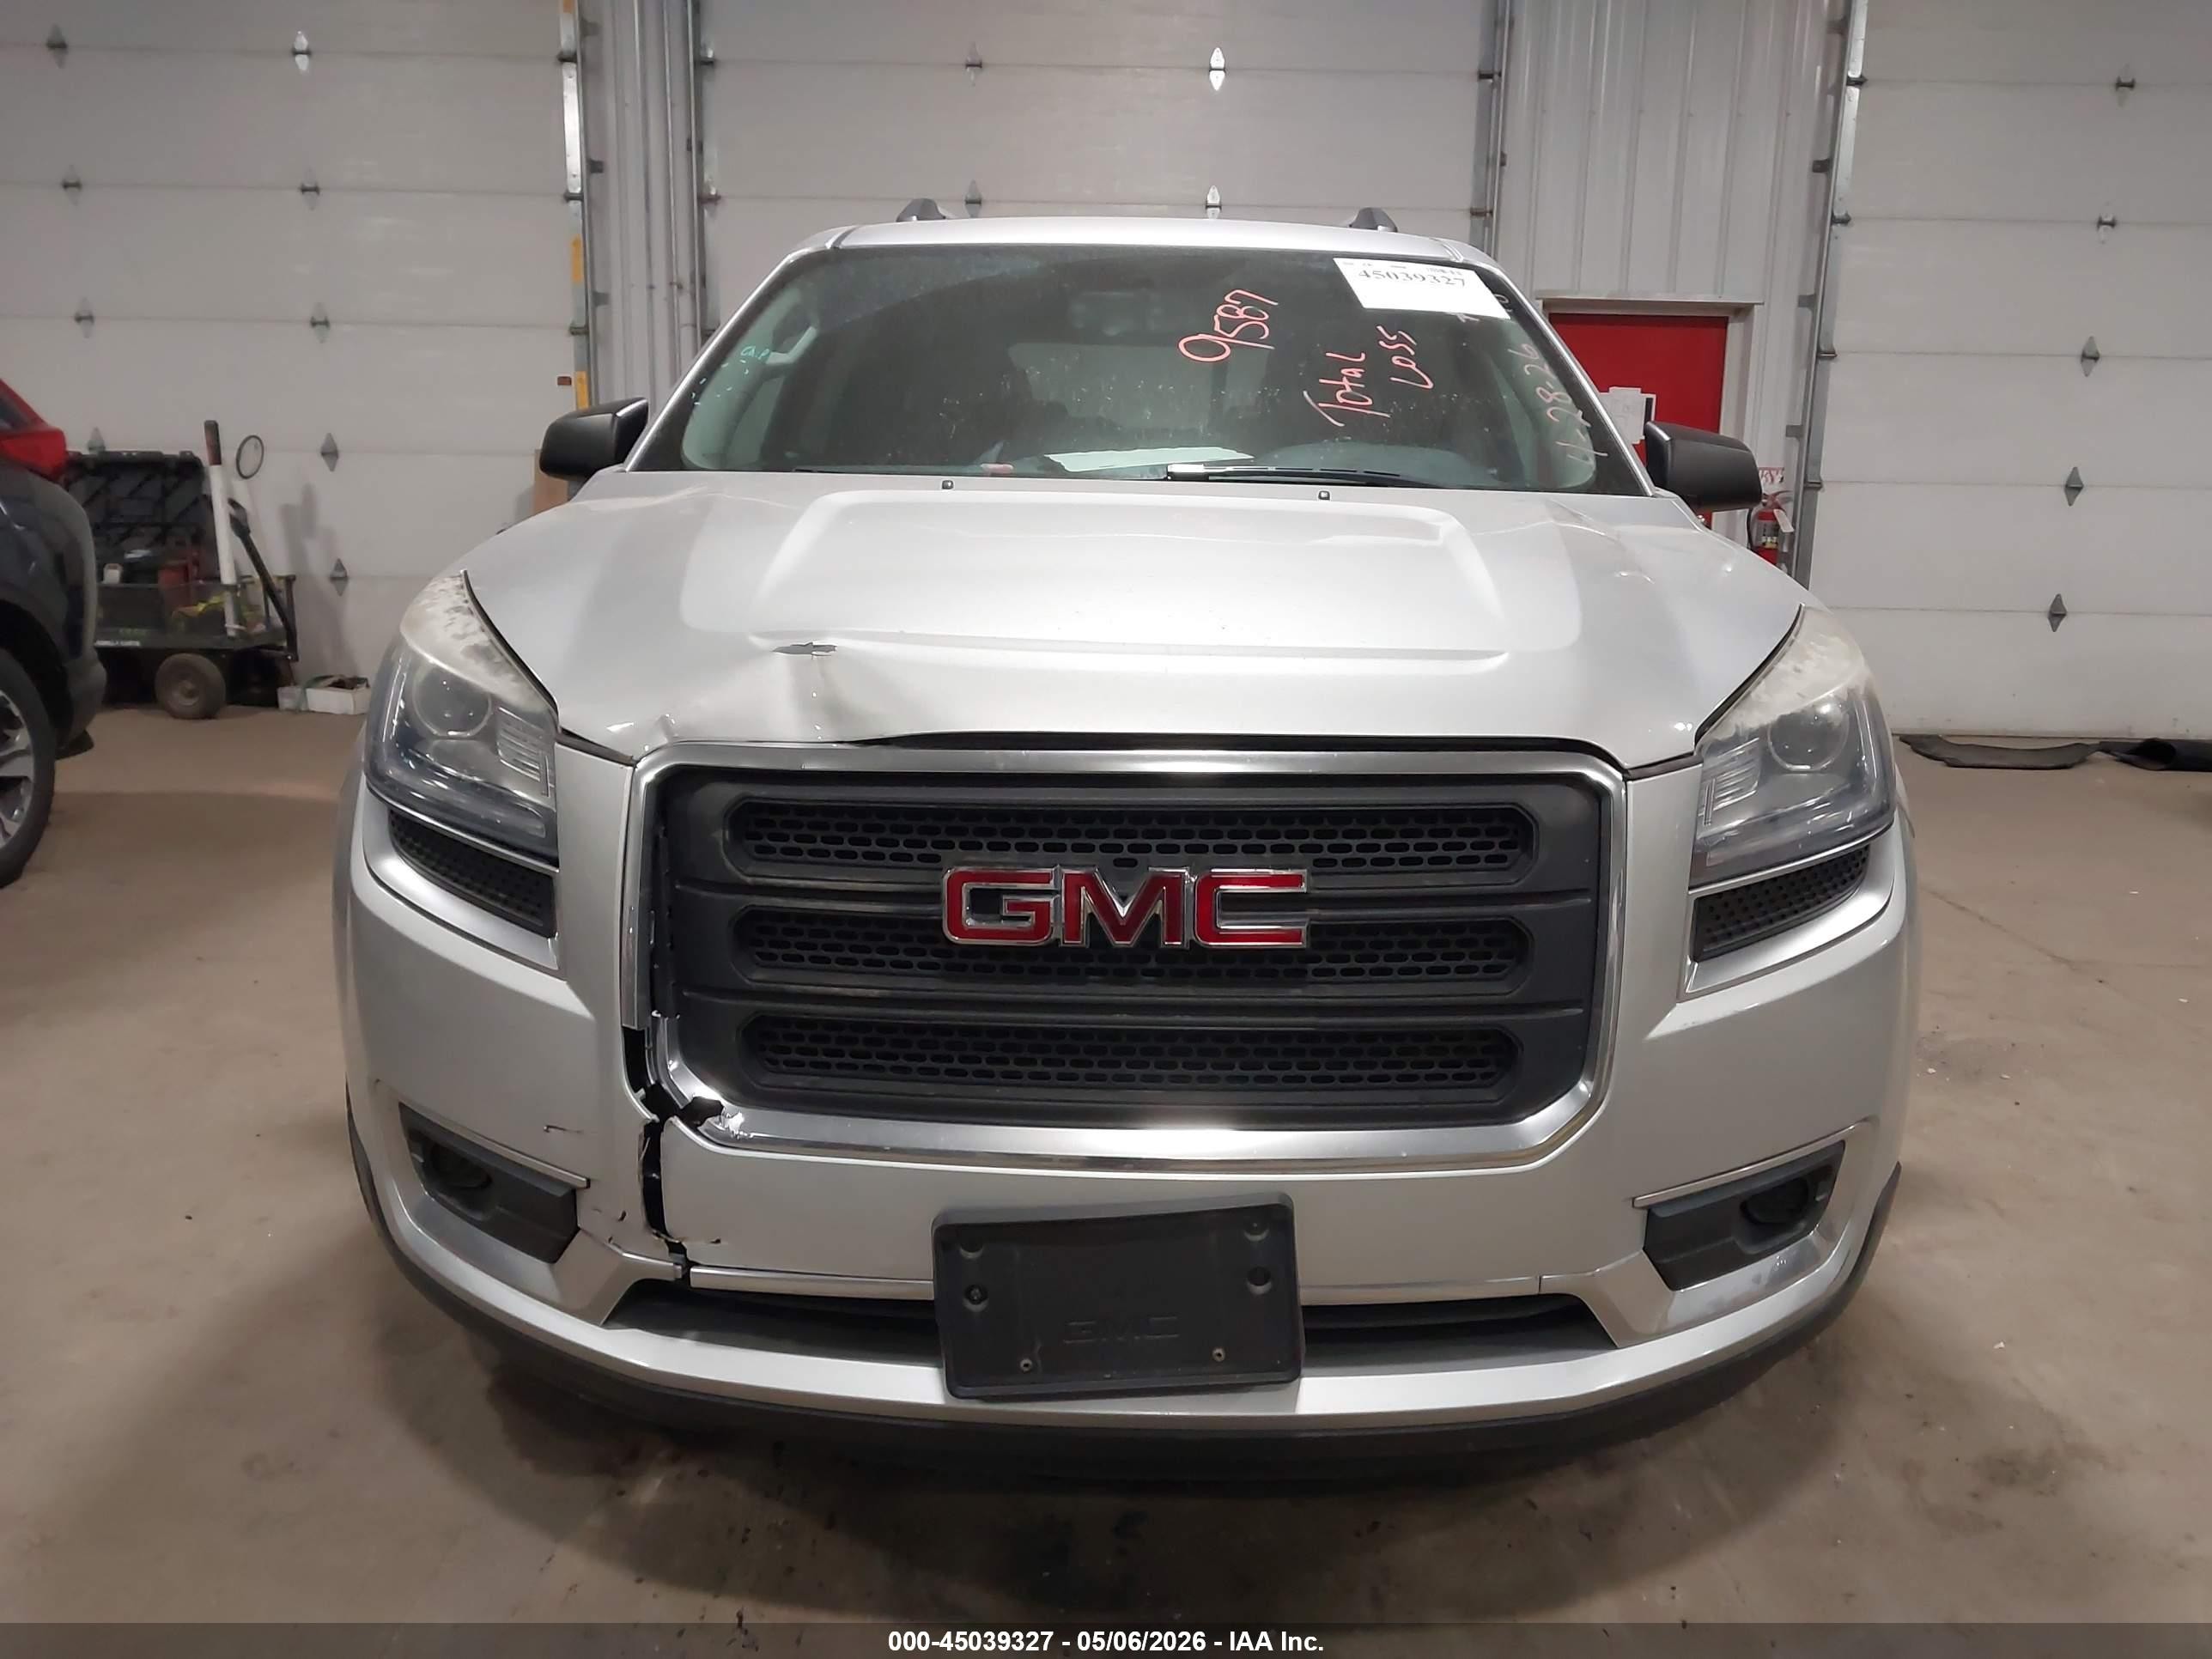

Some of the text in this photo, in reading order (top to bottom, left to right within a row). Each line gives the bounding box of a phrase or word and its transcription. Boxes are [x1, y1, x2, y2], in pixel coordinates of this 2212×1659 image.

[1358, 269, 1466, 288] 45039327
[1179, 289, 1278, 362] 9587
[943, 865, 1309, 949] GMC
